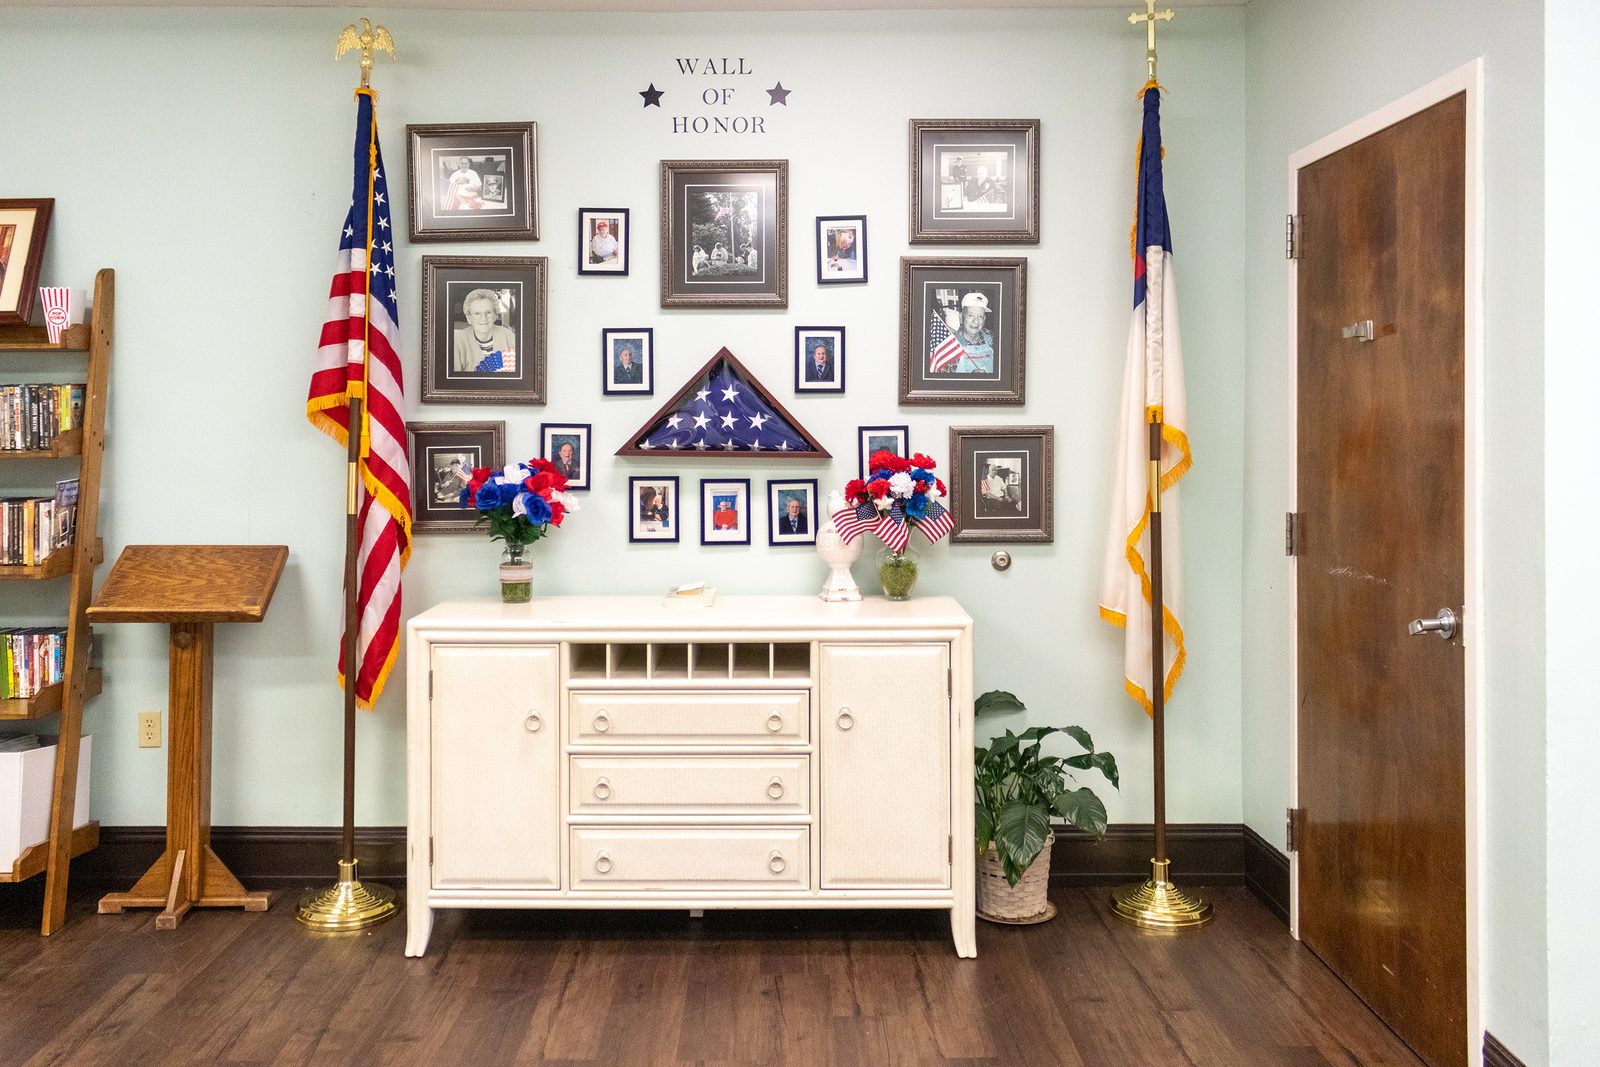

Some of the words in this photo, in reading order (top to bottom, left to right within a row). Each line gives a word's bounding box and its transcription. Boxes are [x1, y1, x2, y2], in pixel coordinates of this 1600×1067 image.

[676, 58, 753, 75] WALL
[702, 88, 736, 106] OF
[672, 116, 766, 134] HONOR
